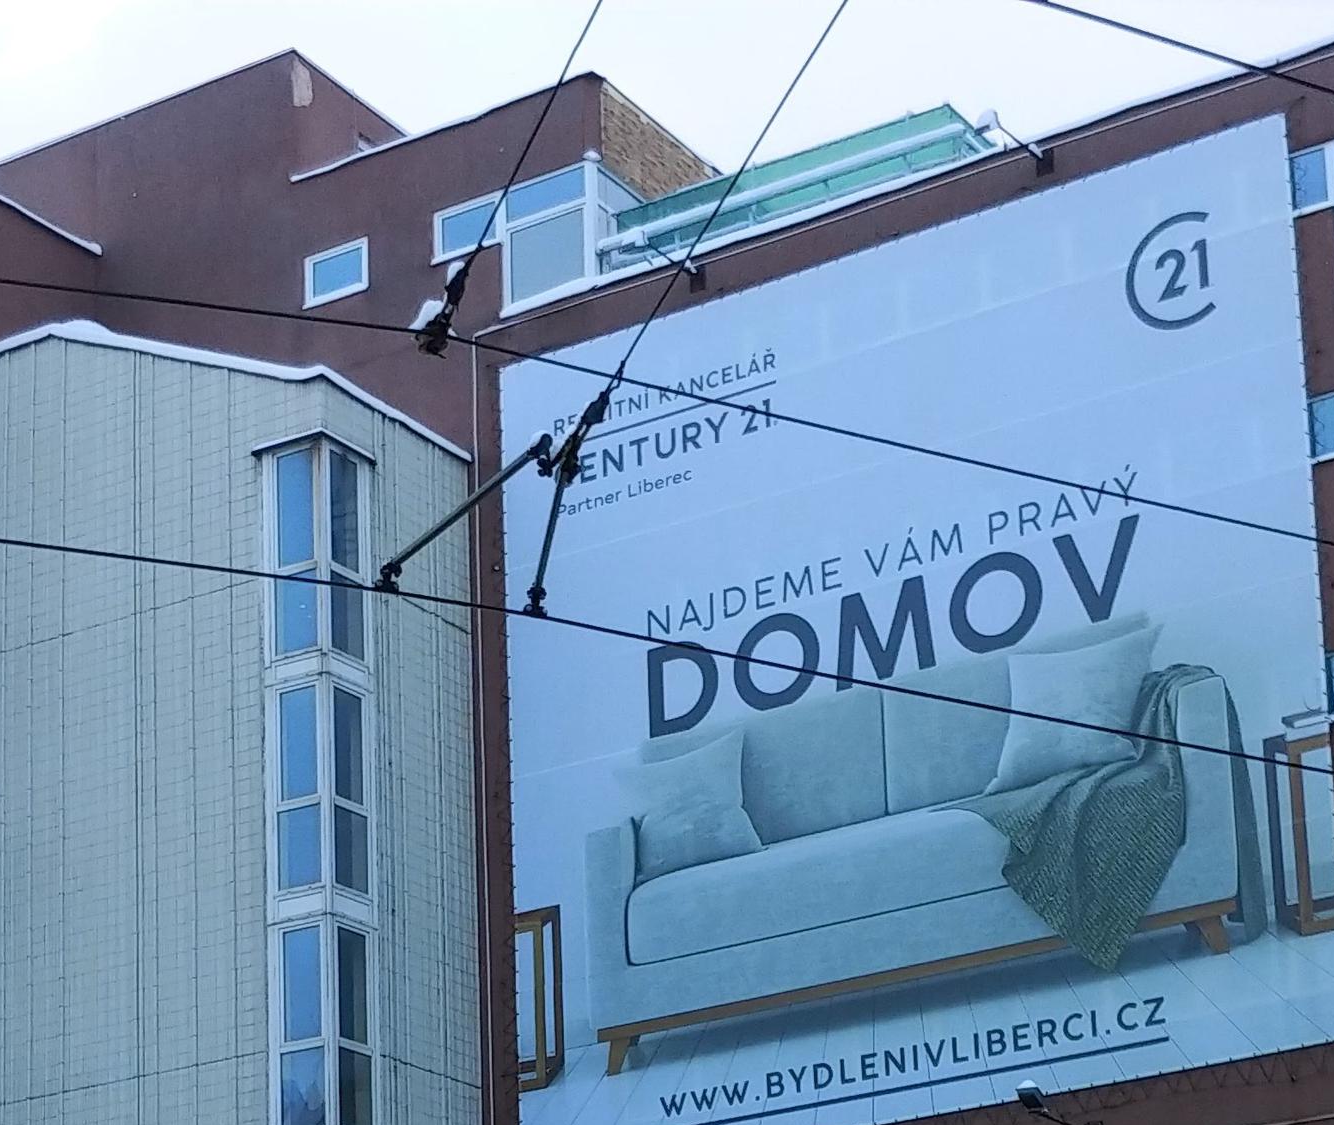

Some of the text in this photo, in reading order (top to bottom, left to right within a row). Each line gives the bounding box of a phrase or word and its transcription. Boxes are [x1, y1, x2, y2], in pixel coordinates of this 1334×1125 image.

[553, 389, 650, 437] REITNÍ
[565, 411, 729, 485] ENTURY
[557, 469, 693, 517] Partner Liberec
[647, 464, 1138, 637] NAJDEME VÁM PRAVÝ
[647, 514, 1141, 739] DOMOV
[660, 997, 1167, 1118] WWW.BYDLENIVLIBERCI.CZ
